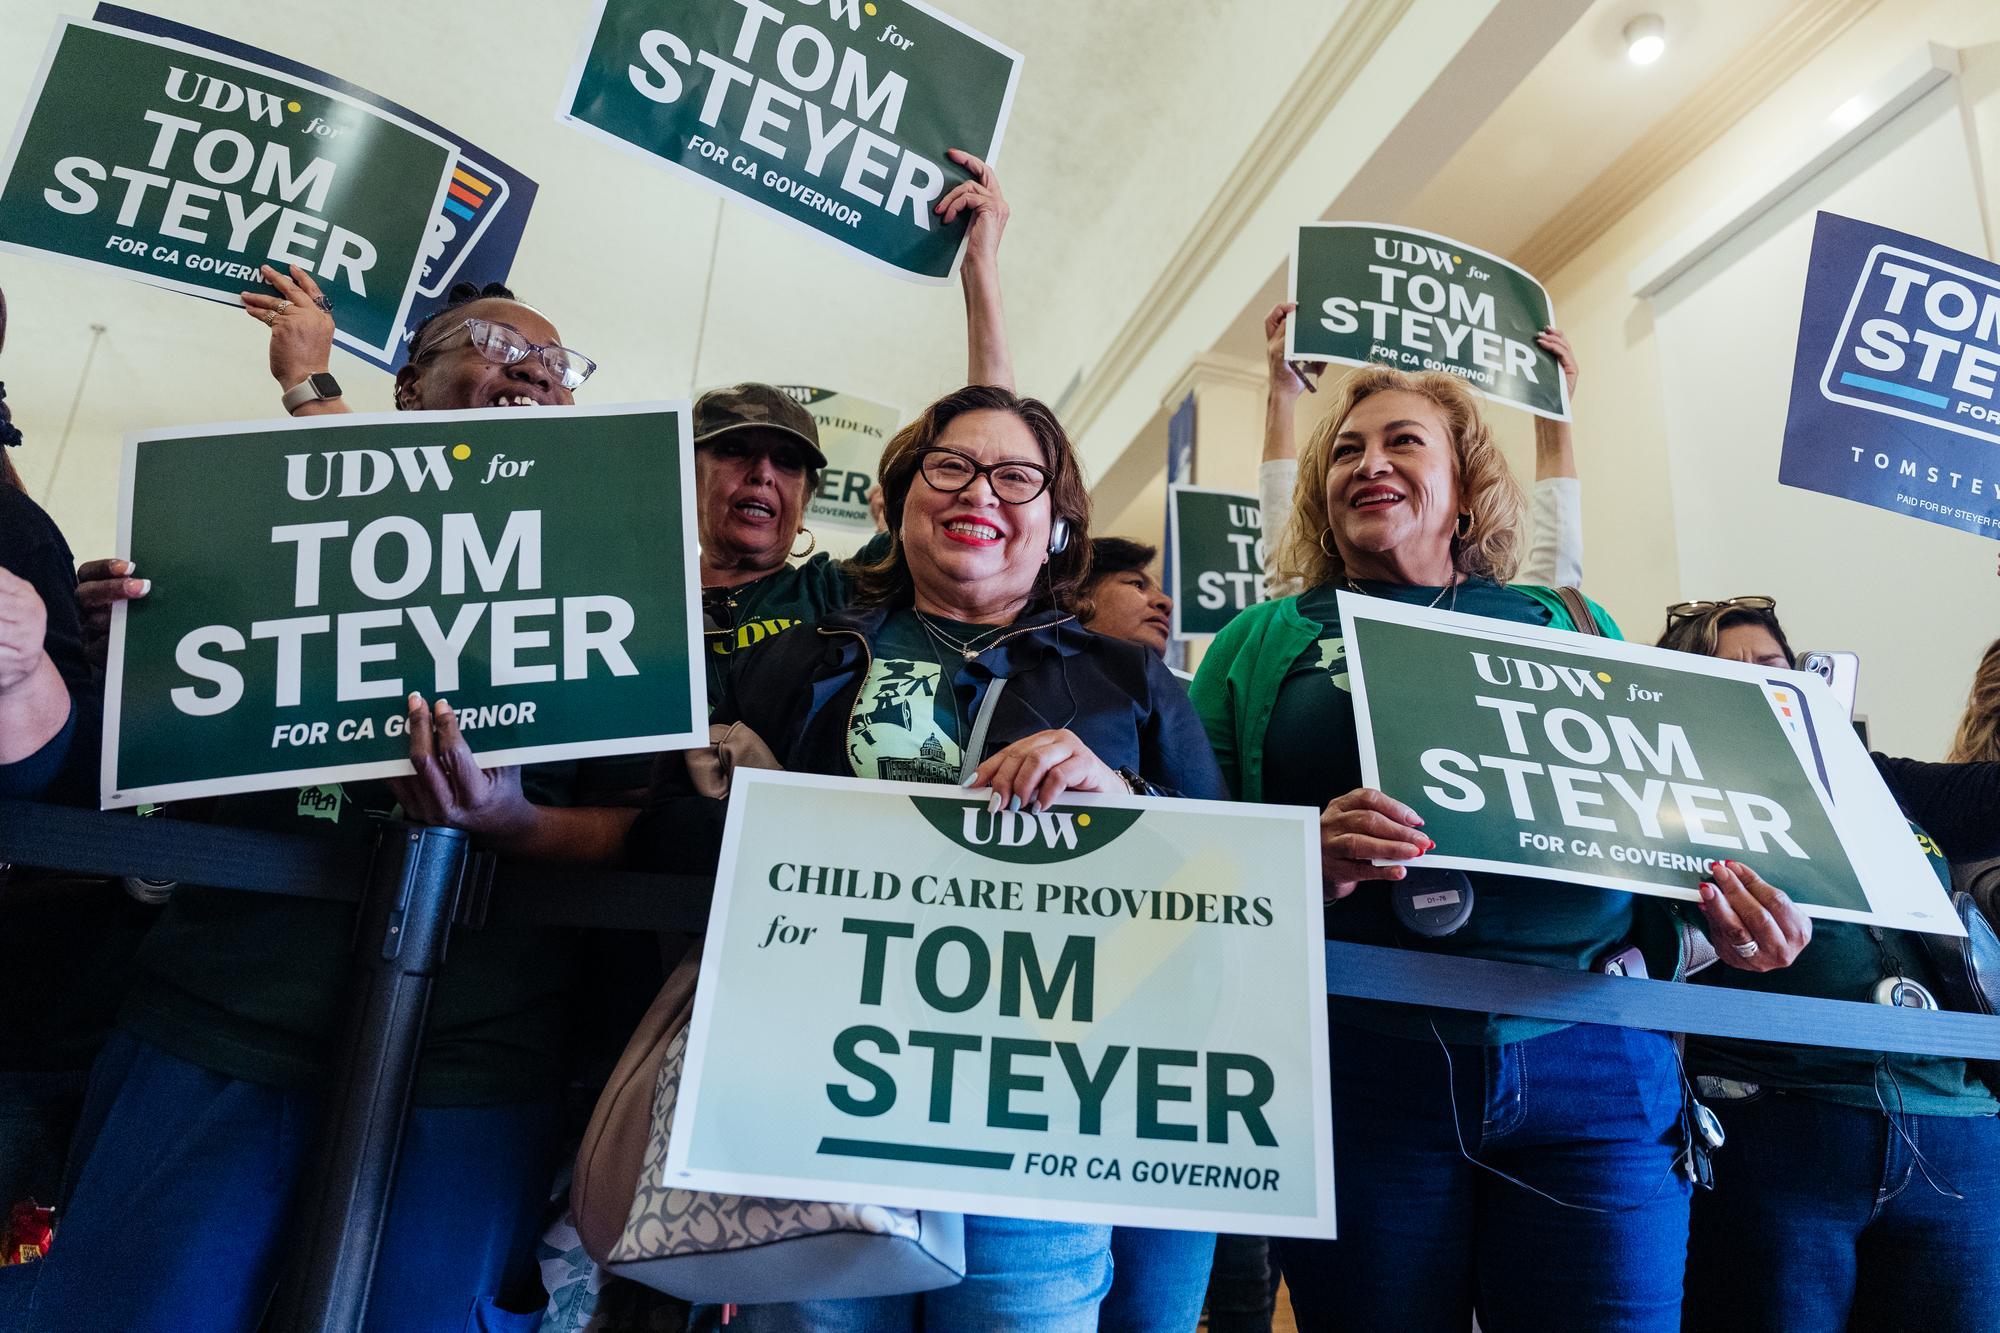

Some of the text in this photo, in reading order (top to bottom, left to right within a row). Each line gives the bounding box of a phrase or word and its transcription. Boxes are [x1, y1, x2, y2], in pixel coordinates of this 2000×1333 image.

[733, 0, 908, 134] TOM
[877, 24, 914, 51] for
[164, 66, 344, 141] UDW for
[628, 29, 945, 231] STEYER
[144, 110, 337, 212] TOM
[687, 135, 862, 229] FOR CA GOVERNOR
[43, 157, 378, 298] STEYER
[105, 236, 149, 257] FOR
[152, 246, 180, 264] CA
[1373, 237, 1490, 282] UDW for
[1368, 264, 1496, 330] TOM
[1320, 296, 1539, 385] STEYER
[1371, 345, 1495, 386] FOR CA GOVERNOR
[1956, 401, 2000, 425] FOR
[285, 445, 535, 501] UDW for
[811, 504, 868, 520] GOVERNOR
[1896, 493, 1918, 506] PAID
[1920, 500, 1939, 512] FOR
[1940, 505, 1953, 515] BY
[1954, 509, 1990, 526] STEYER
[272, 509, 541, 607] TOM
[170, 595, 640, 717] STEYER
[1470, 651, 1663, 703] UDW for
[271, 722, 329, 748] FOR
[337, 718, 374, 742] CA
[1475, 695, 1704, 780] TOM
[962, 807, 1078, 850] UDW
[1419, 748, 1810, 860] STEYER
[1519, 831, 1726, 875] FOR CA GOVERNO
[768, 862, 1274, 927] CHILD CARE PROVIDERS
[757, 914, 1095, 1022] for TOM
[825, 1024, 1279, 1147] STEYER
[1024, 1152, 1281, 1192] FOR CA GOVERNOR
